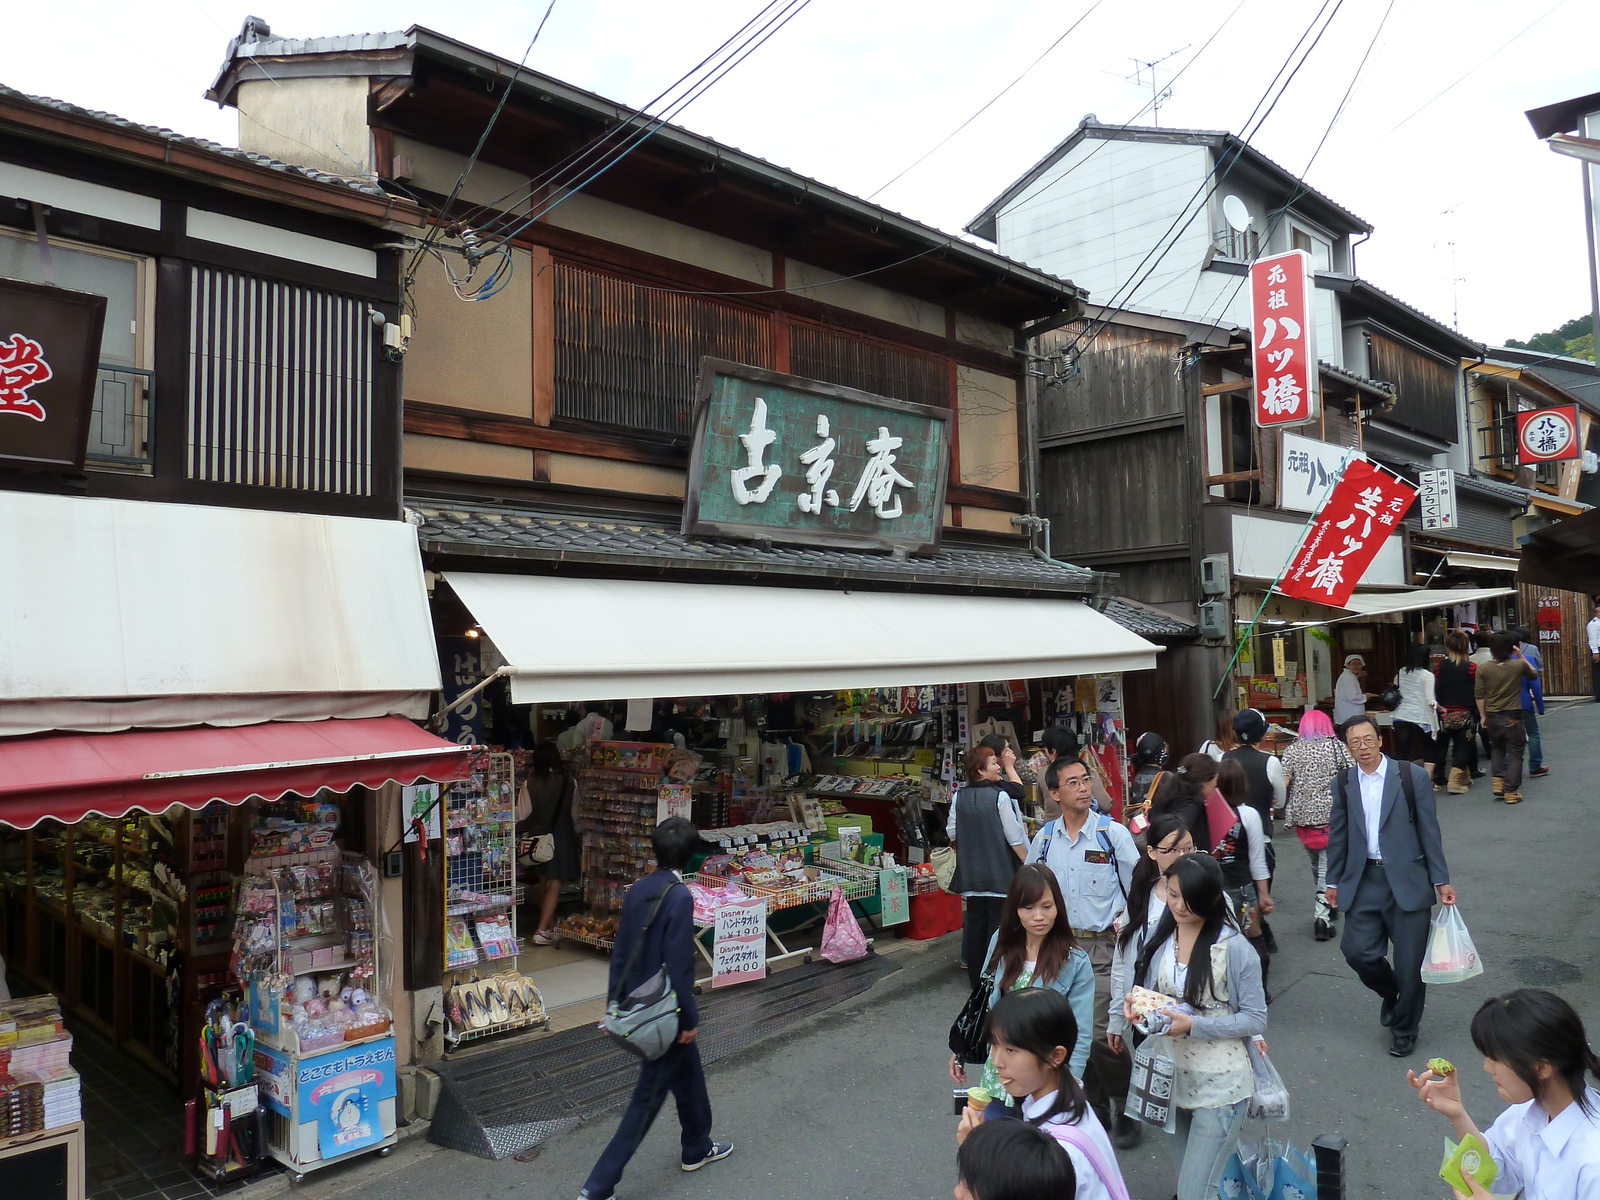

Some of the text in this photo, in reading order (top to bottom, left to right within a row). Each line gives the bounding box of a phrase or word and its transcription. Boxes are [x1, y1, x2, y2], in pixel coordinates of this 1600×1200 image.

[731, 397, 915, 519] 古京庵
[1378, 497, 1404, 526] 元祖
[1423, 473, 1437, 528] こうらく堂
[1539, 630, 1560, 640] 岡本
[1054, 684, 1075, 714] 侍
[887, 878, 902, 913] 新茶
[721, 910, 745, 918] Disney
[723, 914, 759, 929] ハンドタオル
[719, 950, 758, 965] フェイスタオル
[720, 945, 744, 954] Disney
